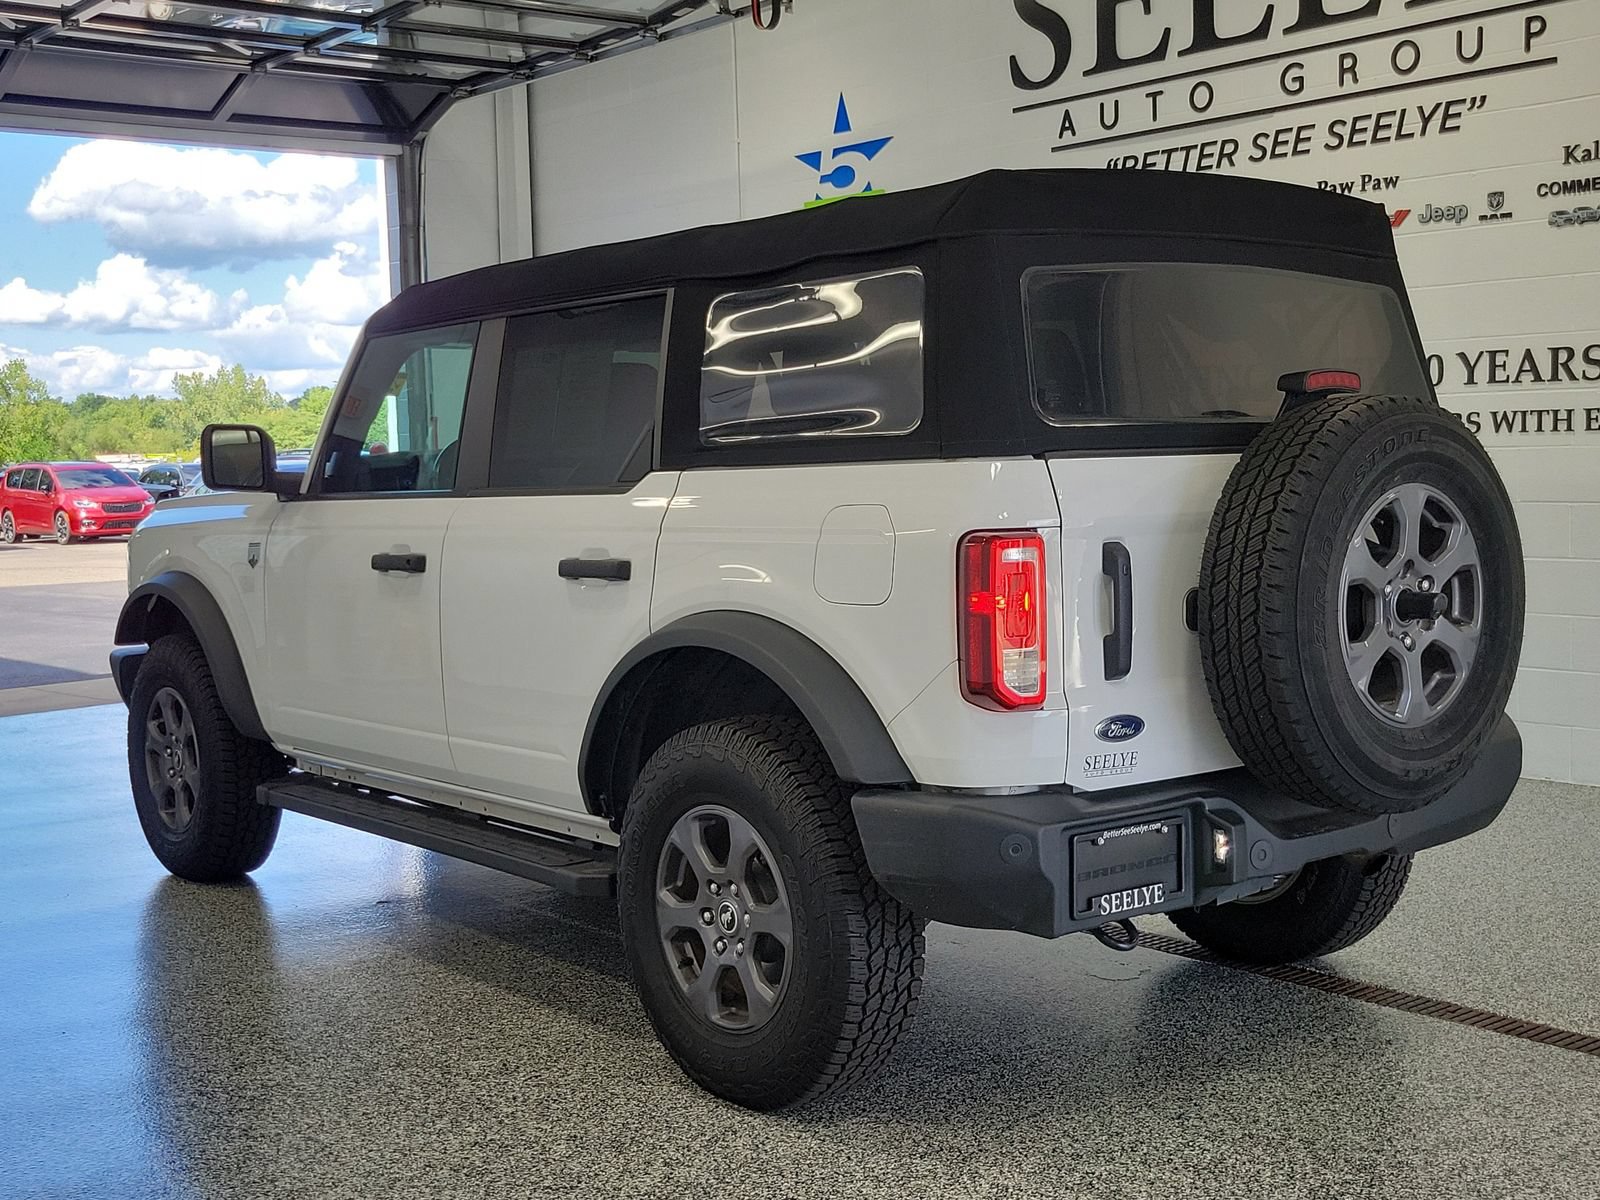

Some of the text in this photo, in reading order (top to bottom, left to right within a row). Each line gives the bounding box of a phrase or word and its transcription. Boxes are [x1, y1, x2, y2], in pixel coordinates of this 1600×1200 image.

[1059, 80, 1214, 138] AUTO
[1280, 15, 1547, 96] GROUP
[1248, 124, 1316, 163] SEE
[1323, 95, 1487, 151] SEELYE”
[1360, 174, 1399, 192] Paw
[1418, 204, 1468, 225] Jeep
[1456, 344, 1600, 386] YEARS
[1490, 408, 1575, 434] WITH
[1108, 721, 1135, 738] Ford
[1083, 751, 1138, 770] SEELYE
[1077, 853, 1177, 883] BRONCO
[1100, 883, 1165, 915] SEELYE
